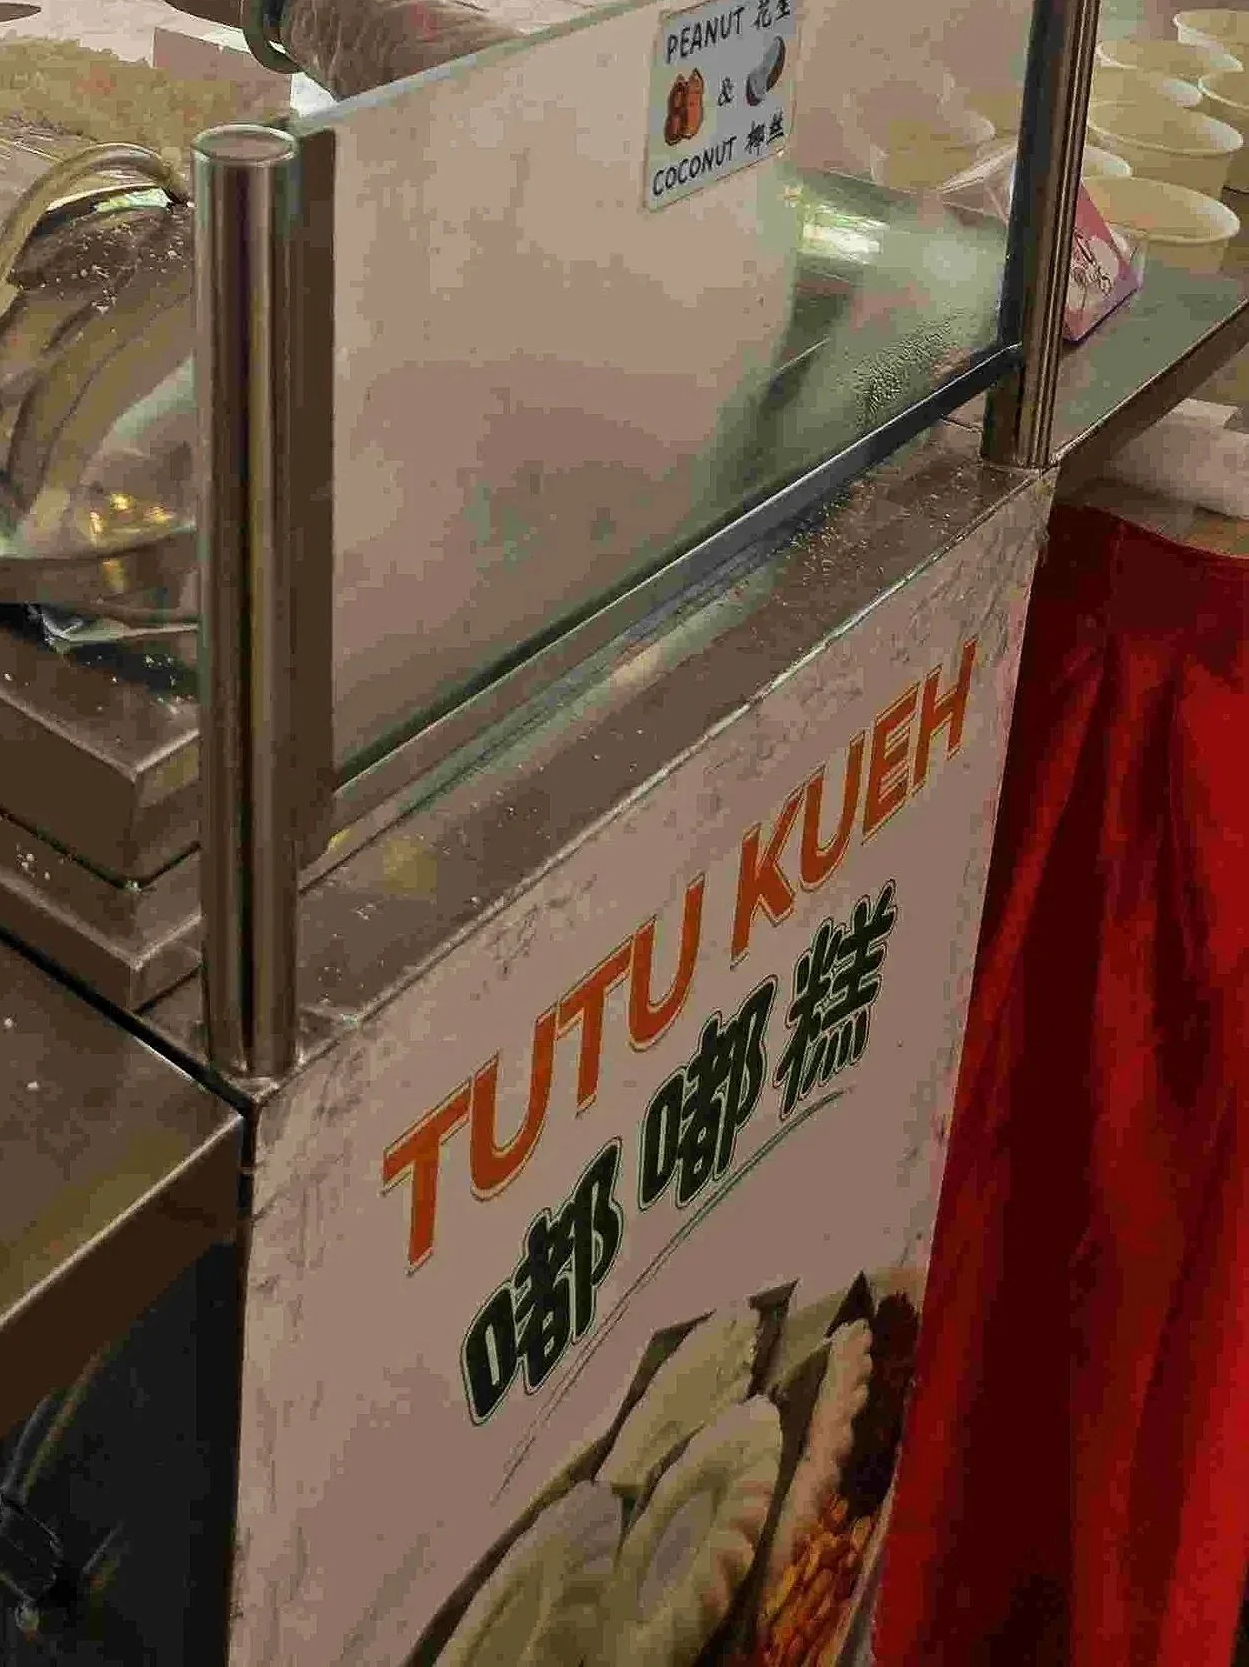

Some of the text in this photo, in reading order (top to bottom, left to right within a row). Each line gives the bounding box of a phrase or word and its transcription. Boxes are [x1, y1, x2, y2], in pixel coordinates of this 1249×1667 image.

[666, 5, 745, 65] PEANUT
[717, 76, 735, 107] &
[652, 136, 738, 197] COCONUT
[382, 639, 977, 1275] TUTU KUEH
[461, 879, 899, 1425] 嘟嘟糕
